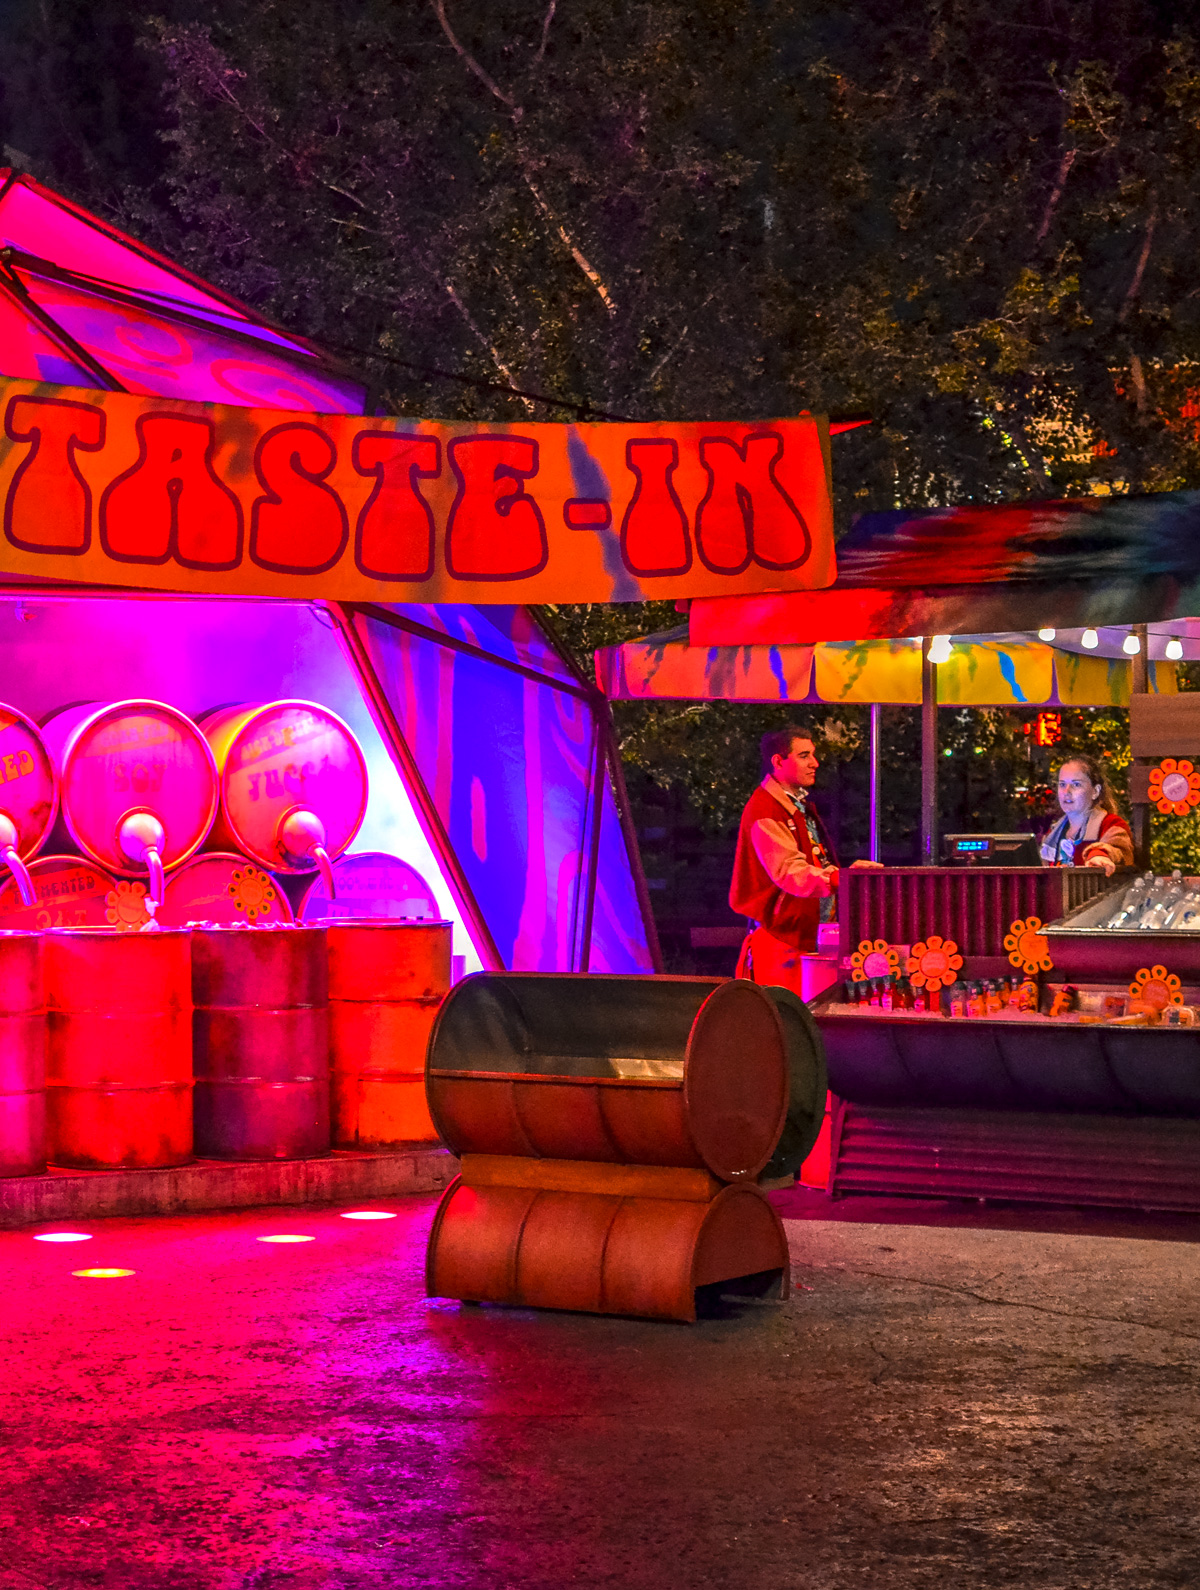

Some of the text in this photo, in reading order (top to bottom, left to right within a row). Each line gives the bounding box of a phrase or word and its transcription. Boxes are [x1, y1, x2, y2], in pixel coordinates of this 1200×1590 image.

[3, 394, 812, 582] TASTE-IN
[113, 763, 168, 793] SOY
[11, 874, 96, 905] FMENTED
